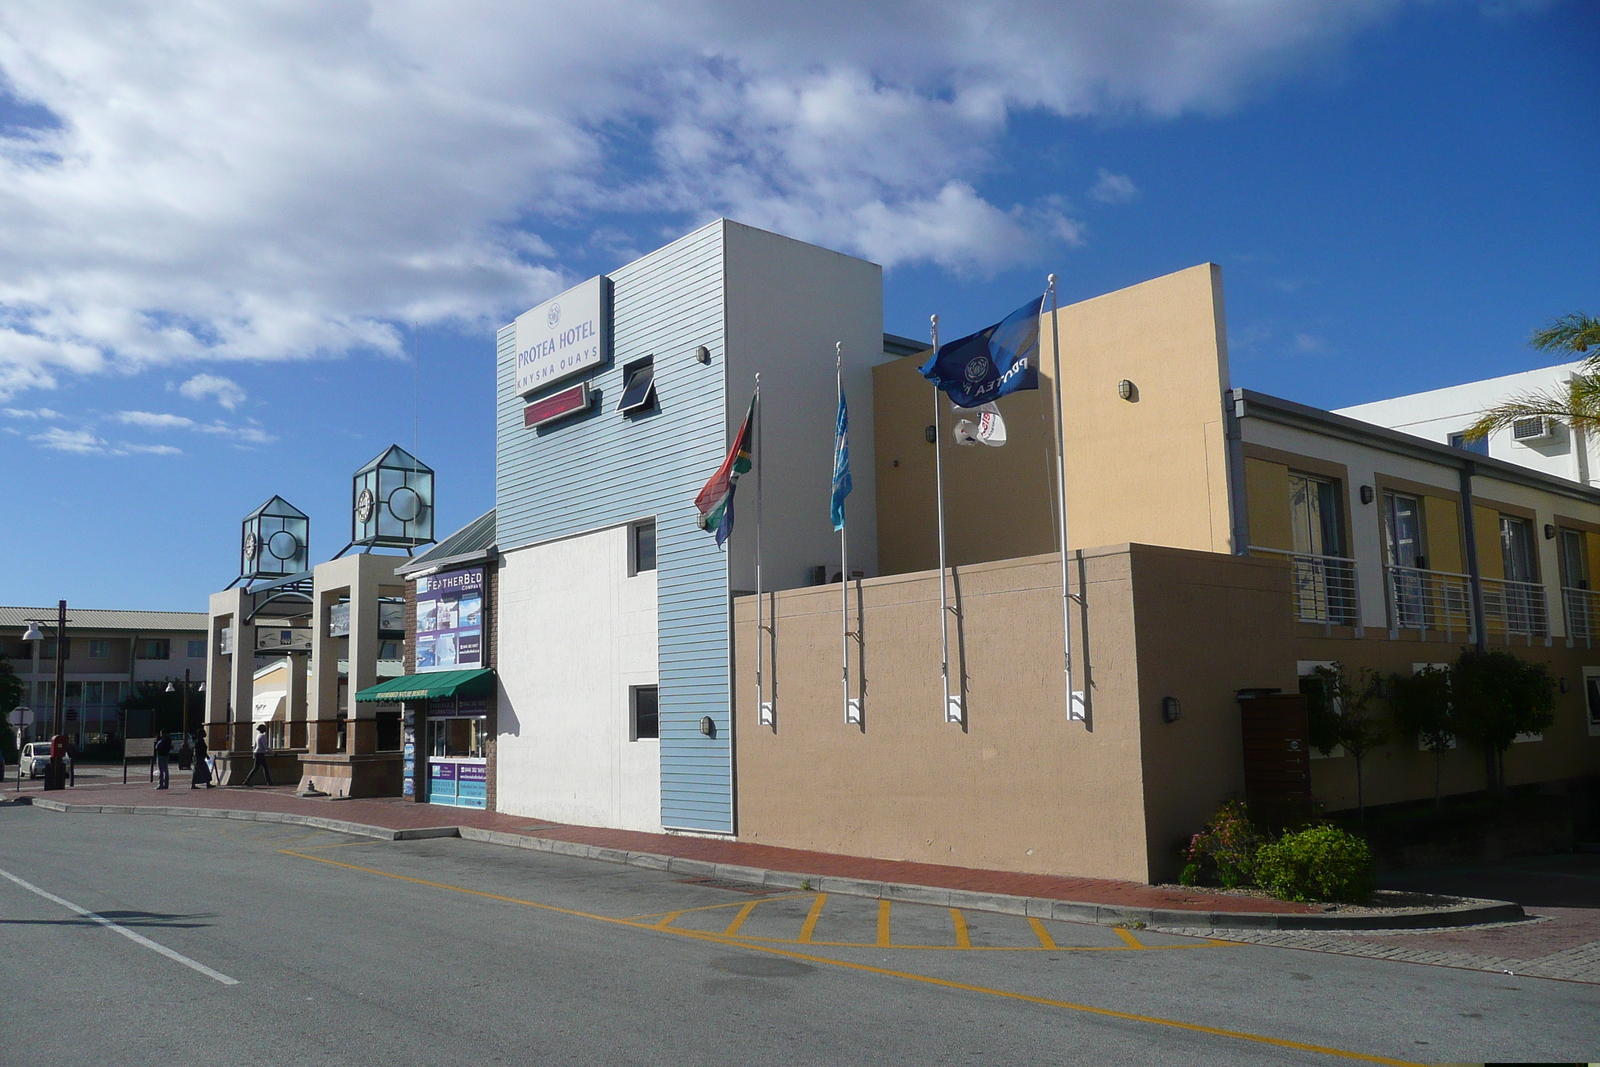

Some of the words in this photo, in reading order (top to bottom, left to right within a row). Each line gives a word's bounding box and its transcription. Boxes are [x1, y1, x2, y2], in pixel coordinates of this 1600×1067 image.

[518, 338, 556, 369] PROTEA
[559, 320, 596, 350] HOTEL
[517, 364, 555, 389] KNYSNA
[560, 346, 598, 371] QUAYS
[427, 573, 482, 591] FEATHERBED
[461, 583, 482, 591] COMPANY
